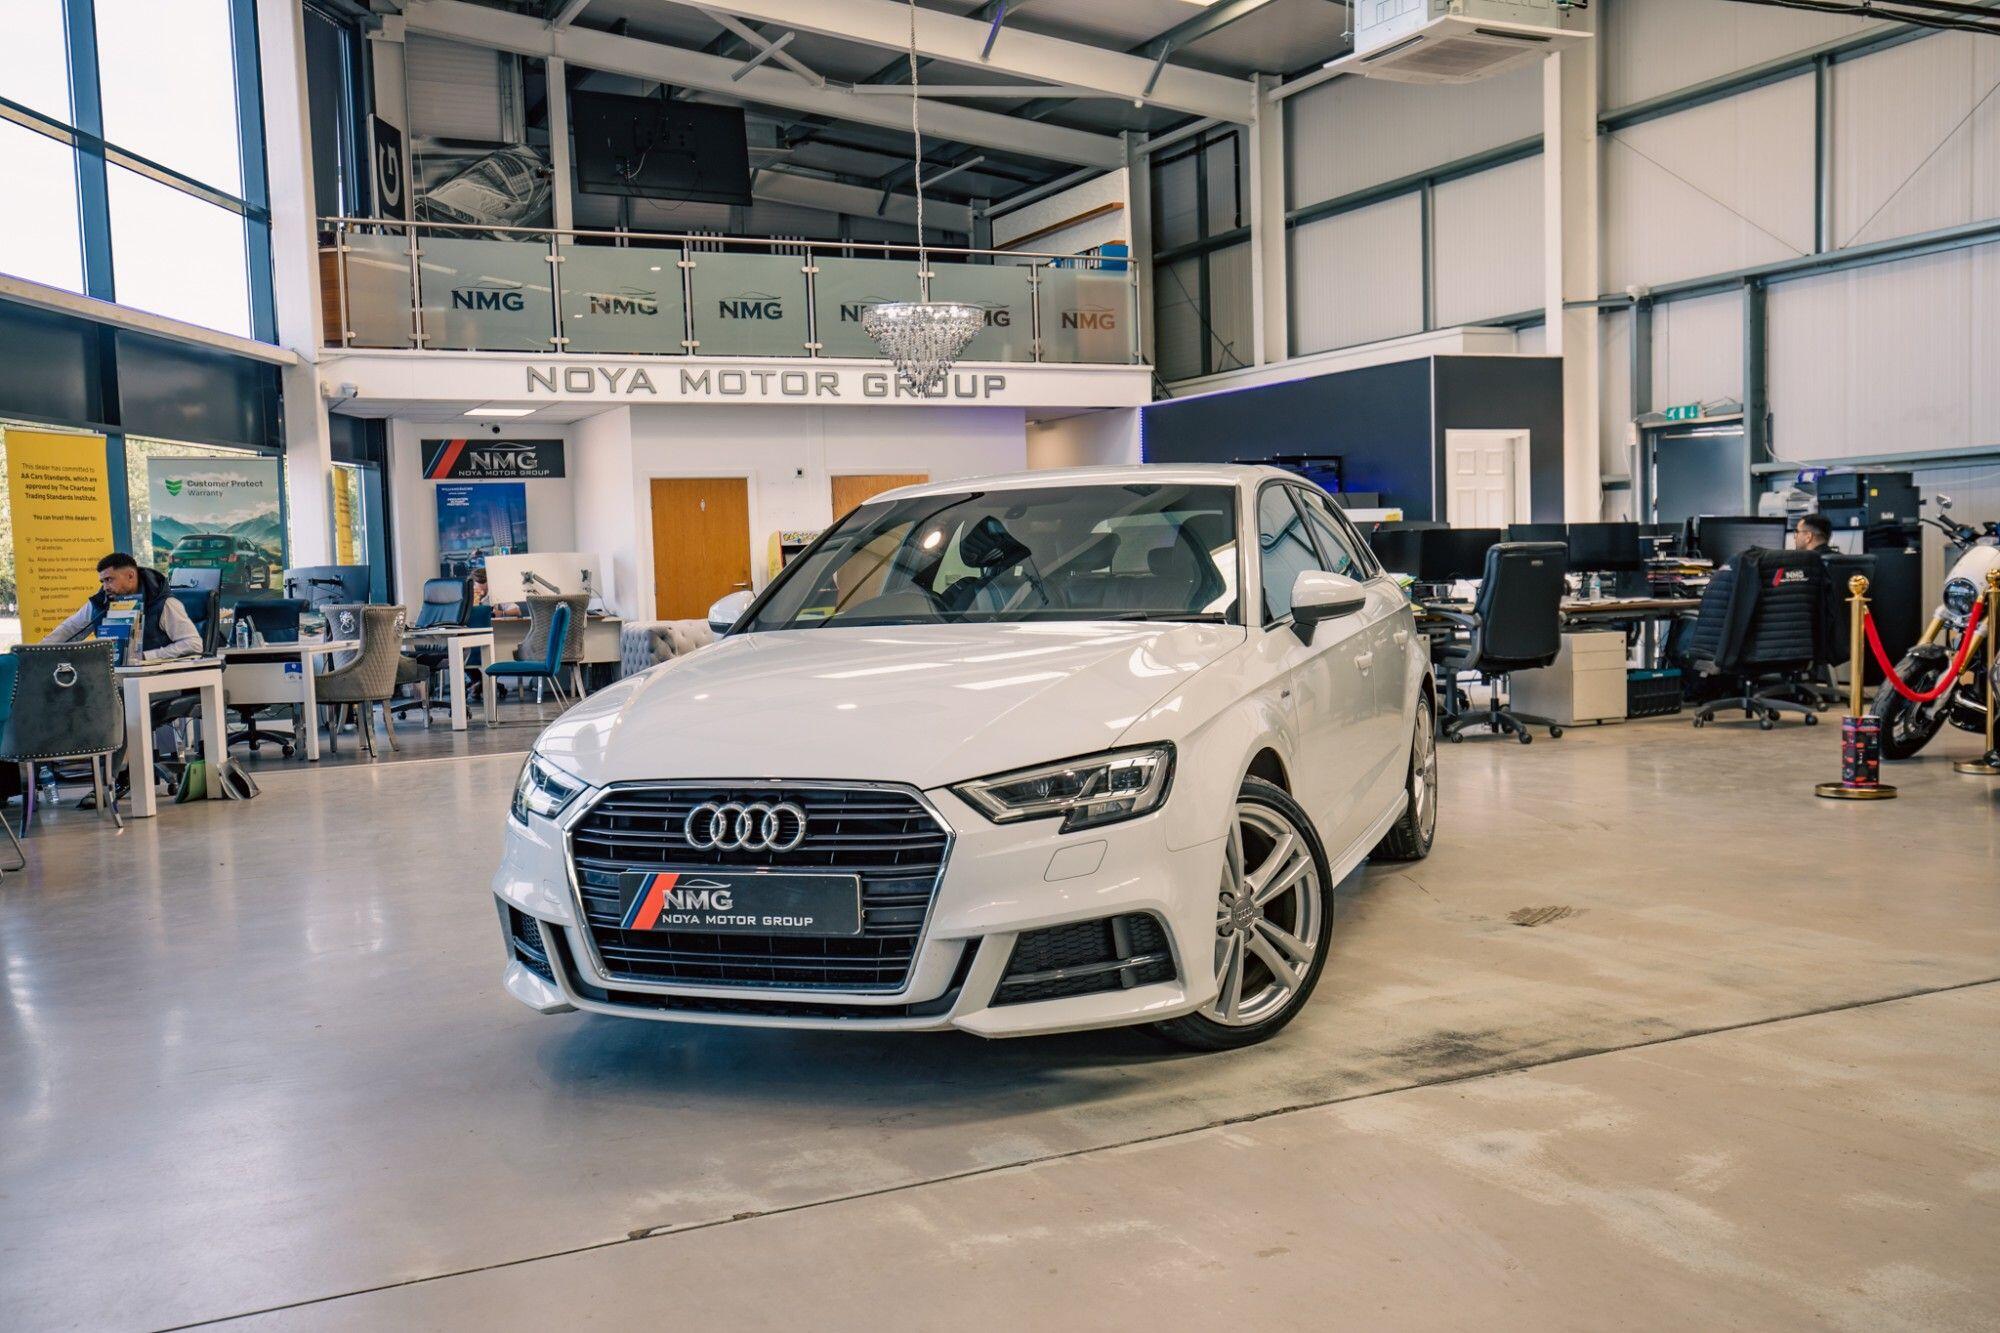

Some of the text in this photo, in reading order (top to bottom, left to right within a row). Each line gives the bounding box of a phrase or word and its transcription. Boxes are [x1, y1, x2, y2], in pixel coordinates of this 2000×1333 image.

[451, 289, 524, 311] NMG
[590, 296, 658, 315] NMG
[719, 301, 783, 320] NMG
[1061, 312, 1115, 329] NMG
[526, 366, 657, 394] NOYA
[680, 368, 841, 397] MOTOR
[470, 451, 538, 470] NMG
[662, 889, 734, 911] NMG
[662, 914, 814, 927] NOYA MOTOR GROUP
